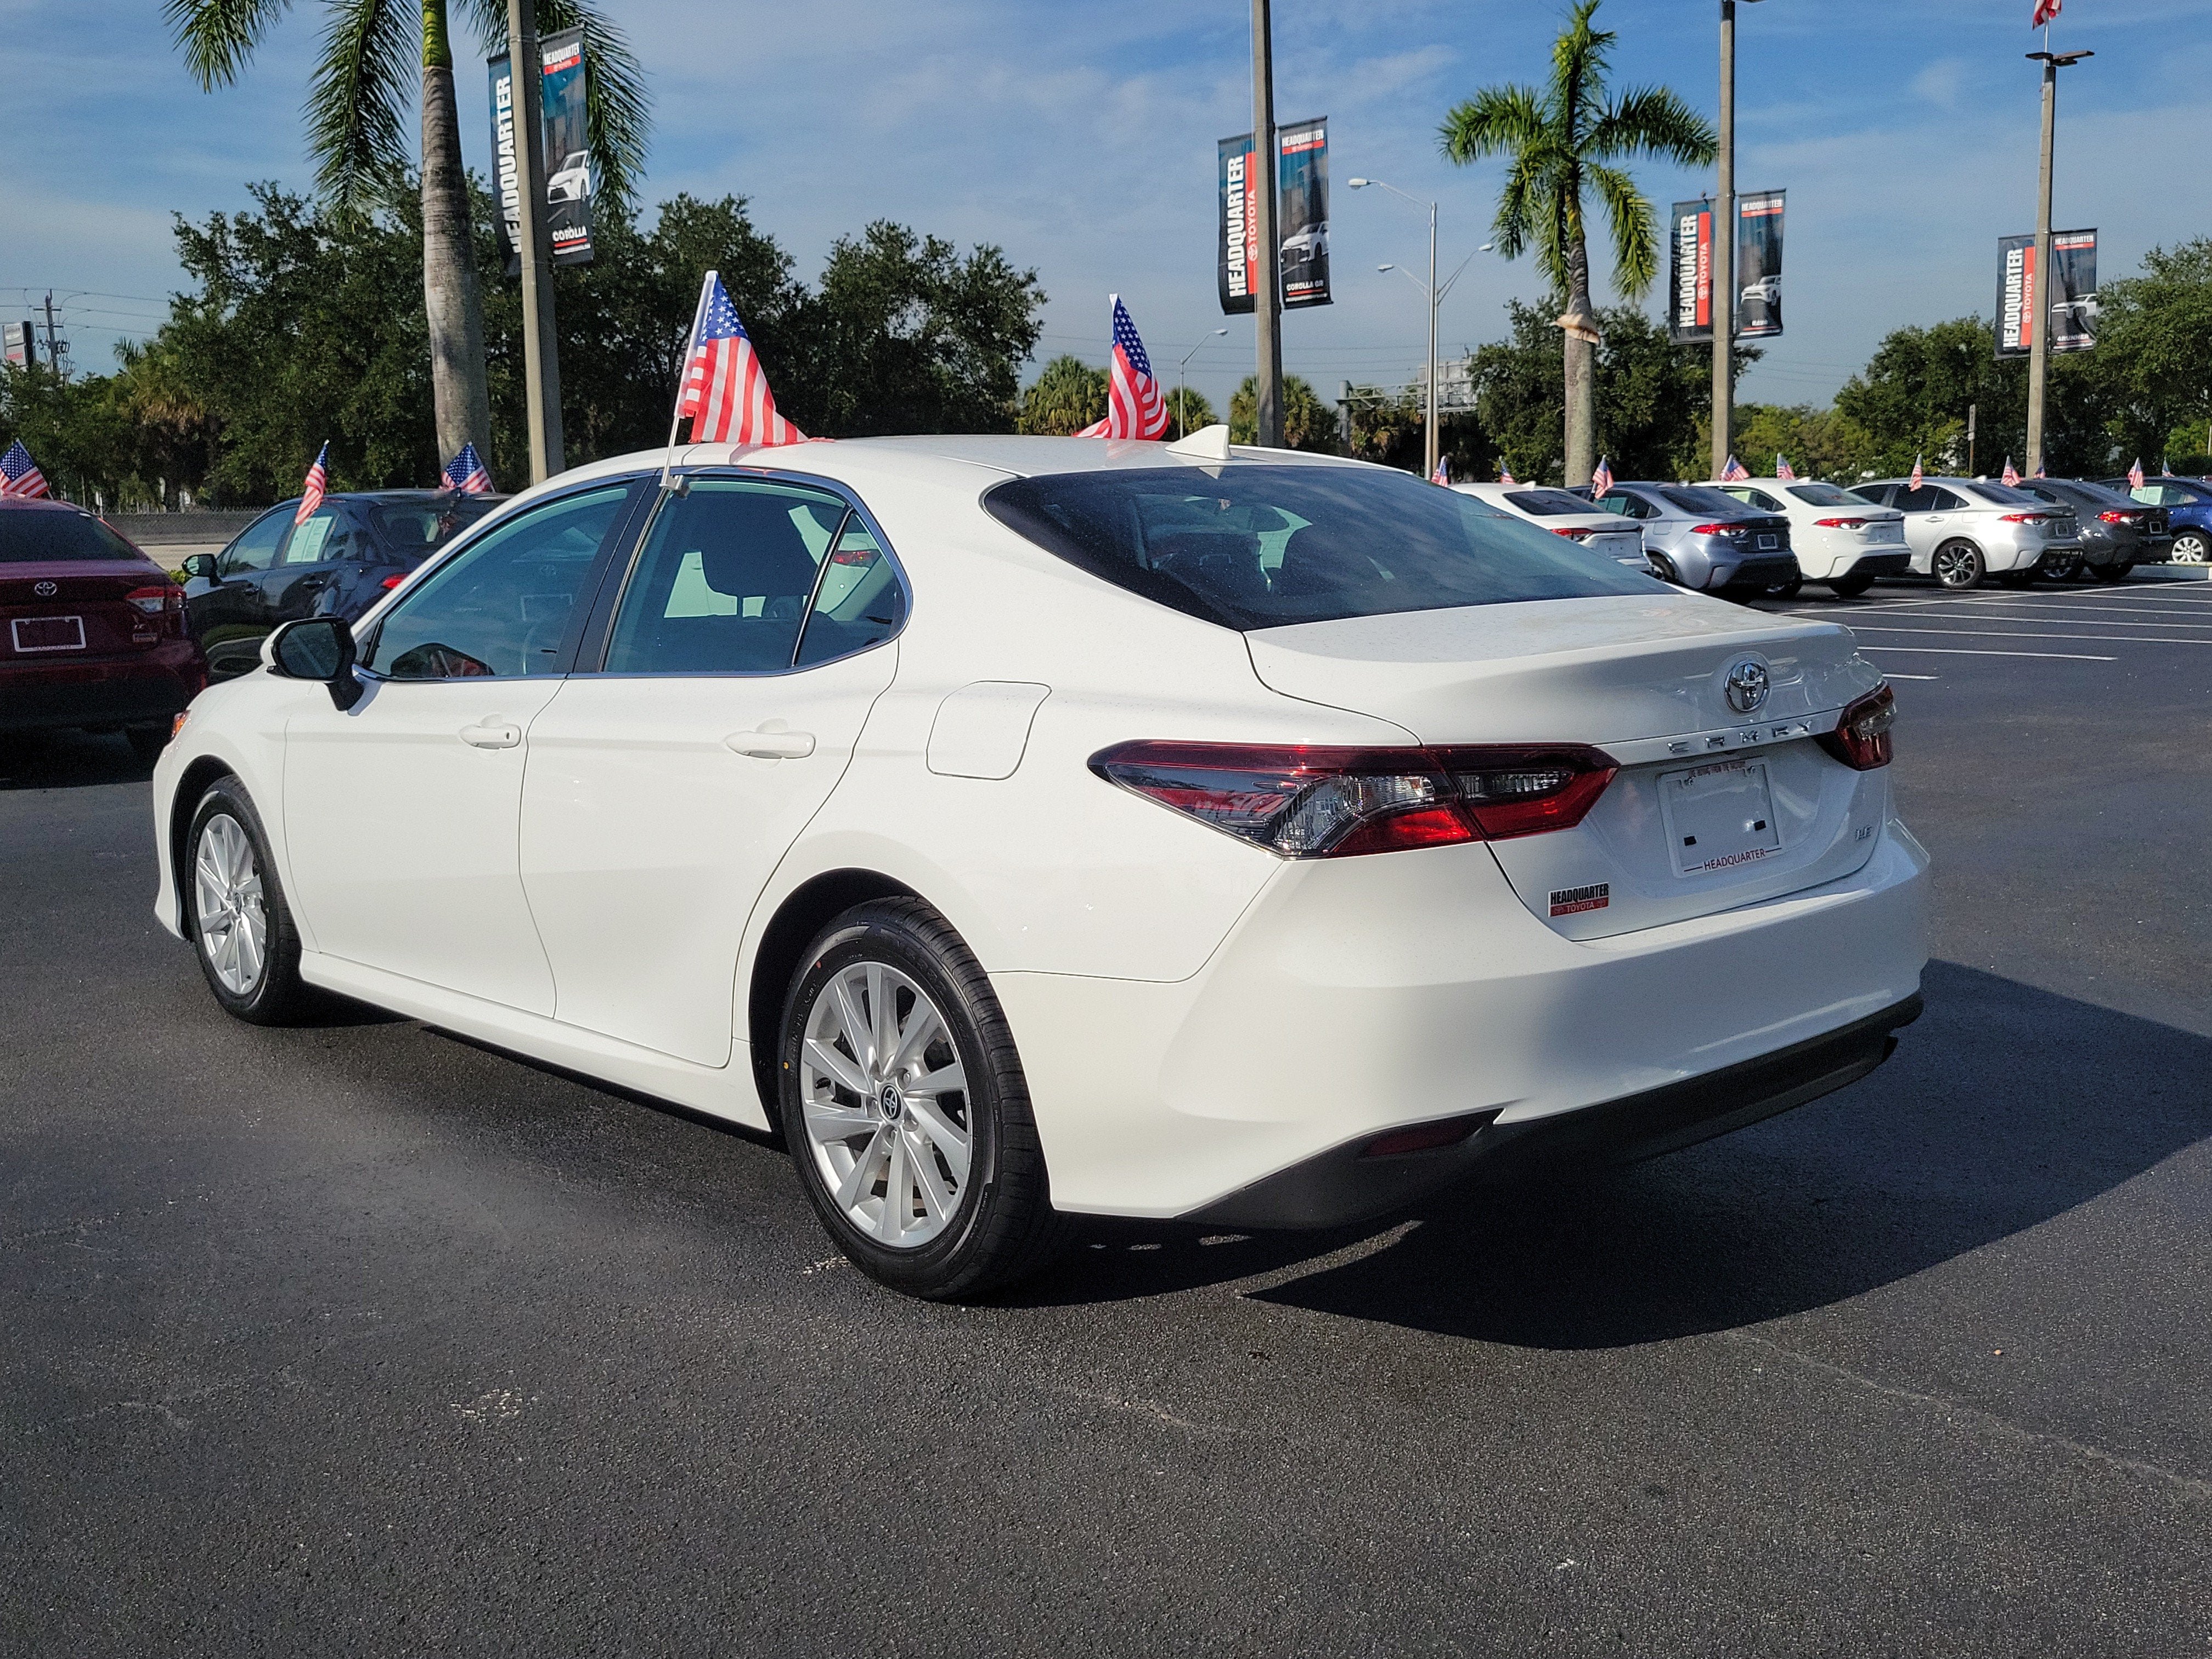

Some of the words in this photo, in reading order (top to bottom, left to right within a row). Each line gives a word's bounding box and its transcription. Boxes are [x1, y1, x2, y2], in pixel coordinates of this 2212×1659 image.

[1227, 156, 1246, 297] HEADQUARTER
[1248, 190, 1257, 242] TOYOTA
[1679, 214, 1697, 328] HEADQUARTER
[1699, 242, 1708, 284] TOYOTA
[2003, 249, 2023, 347] HEADQUARTER
[2024, 273, 2033, 311] TOYOTA
[1703, 848, 1765, 871] HEADQUARTER
[1550, 883, 1609, 905] HEADQUARTER
[1566, 901, 1594, 912] TOYOTA
